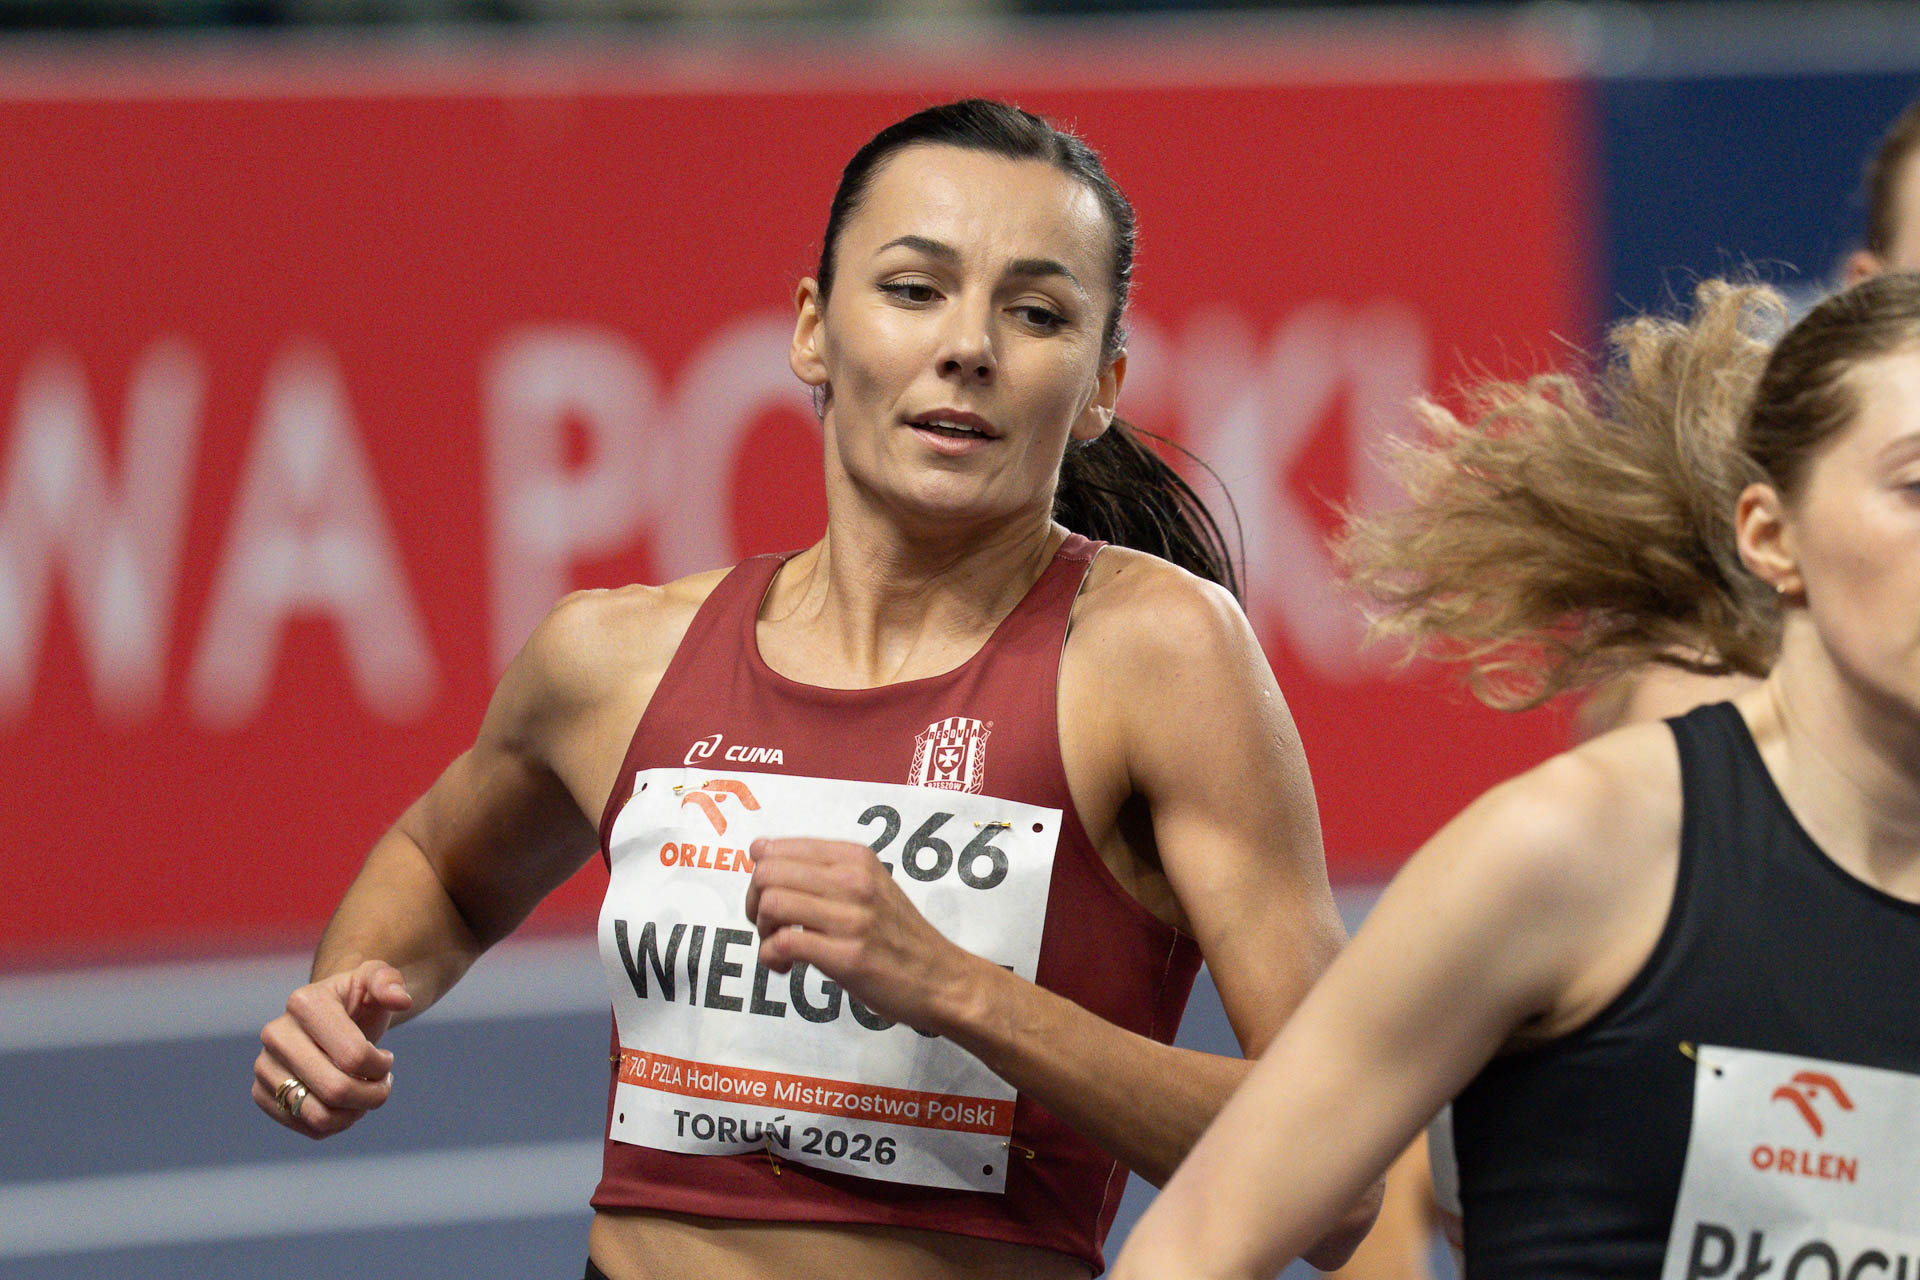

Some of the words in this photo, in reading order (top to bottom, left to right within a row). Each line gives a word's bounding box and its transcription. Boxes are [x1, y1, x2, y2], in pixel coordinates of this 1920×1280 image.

[725, 745, 784, 766] CUNA
[928, 729, 979, 740] RESOVIA
[659, 842, 755, 874] ORLEN
[856, 804, 1009, 890] 266
[614, 919, 1014, 1038] WIELG
[629, 1055, 648, 1080] 70.
[650, 1061, 682, 1087] PZLA
[687, 1068, 767, 1098] Halowe
[773, 1079, 920, 1119] Mistrzostwa
[927, 1099, 996, 1127] Polski
[673, 1109, 792, 1150] TORUŃ
[800, 1126, 897, 1166] 2026
[1751, 1146, 1859, 1183] ORLEN
